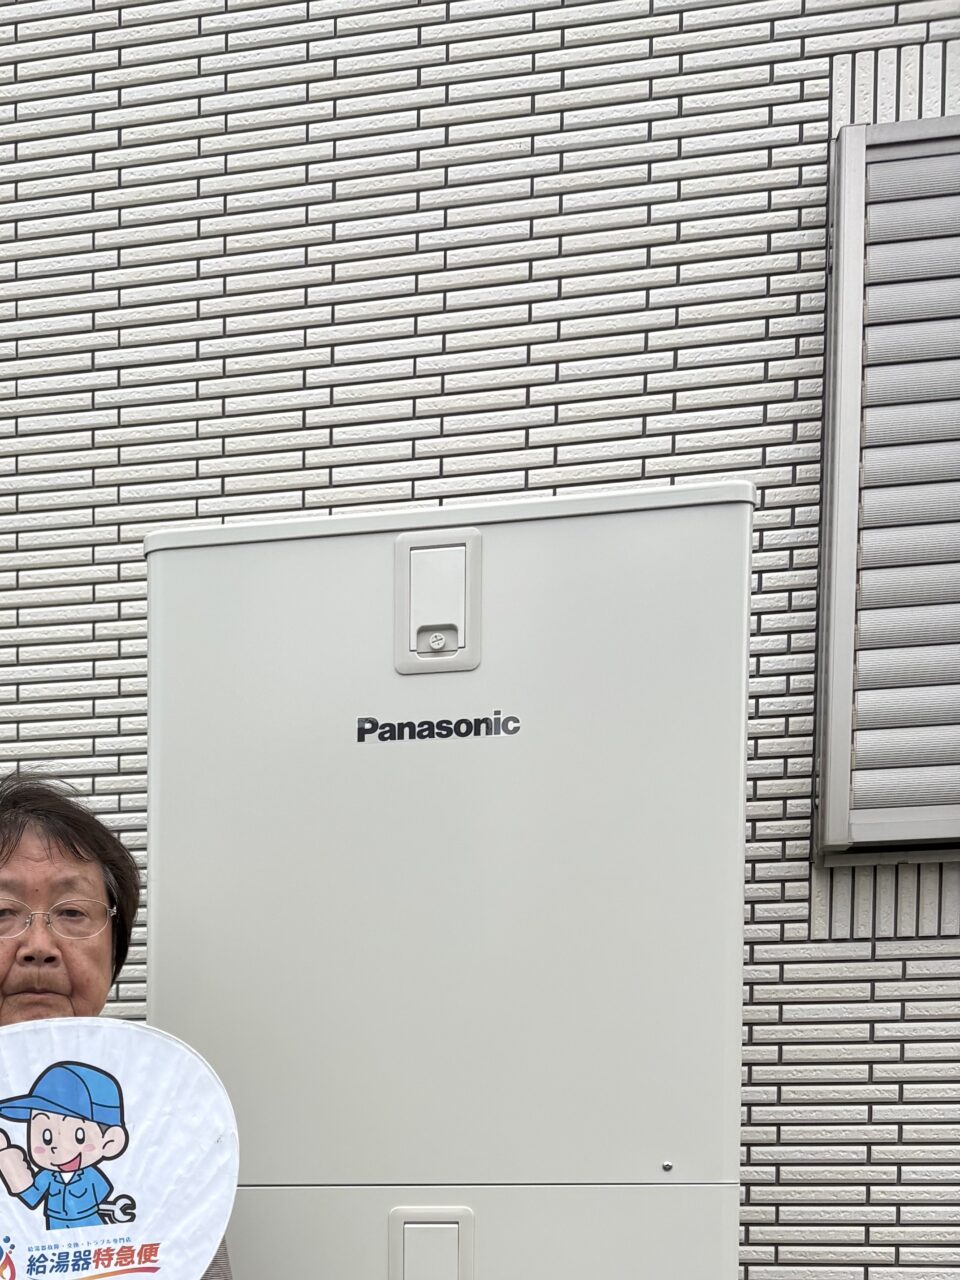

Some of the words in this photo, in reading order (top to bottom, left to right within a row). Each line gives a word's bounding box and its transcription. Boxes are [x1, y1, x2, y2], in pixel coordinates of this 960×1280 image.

[356, 709, 521, 743] Panasonic
[26, 1242, 162, 1276] 給湯器特急便
